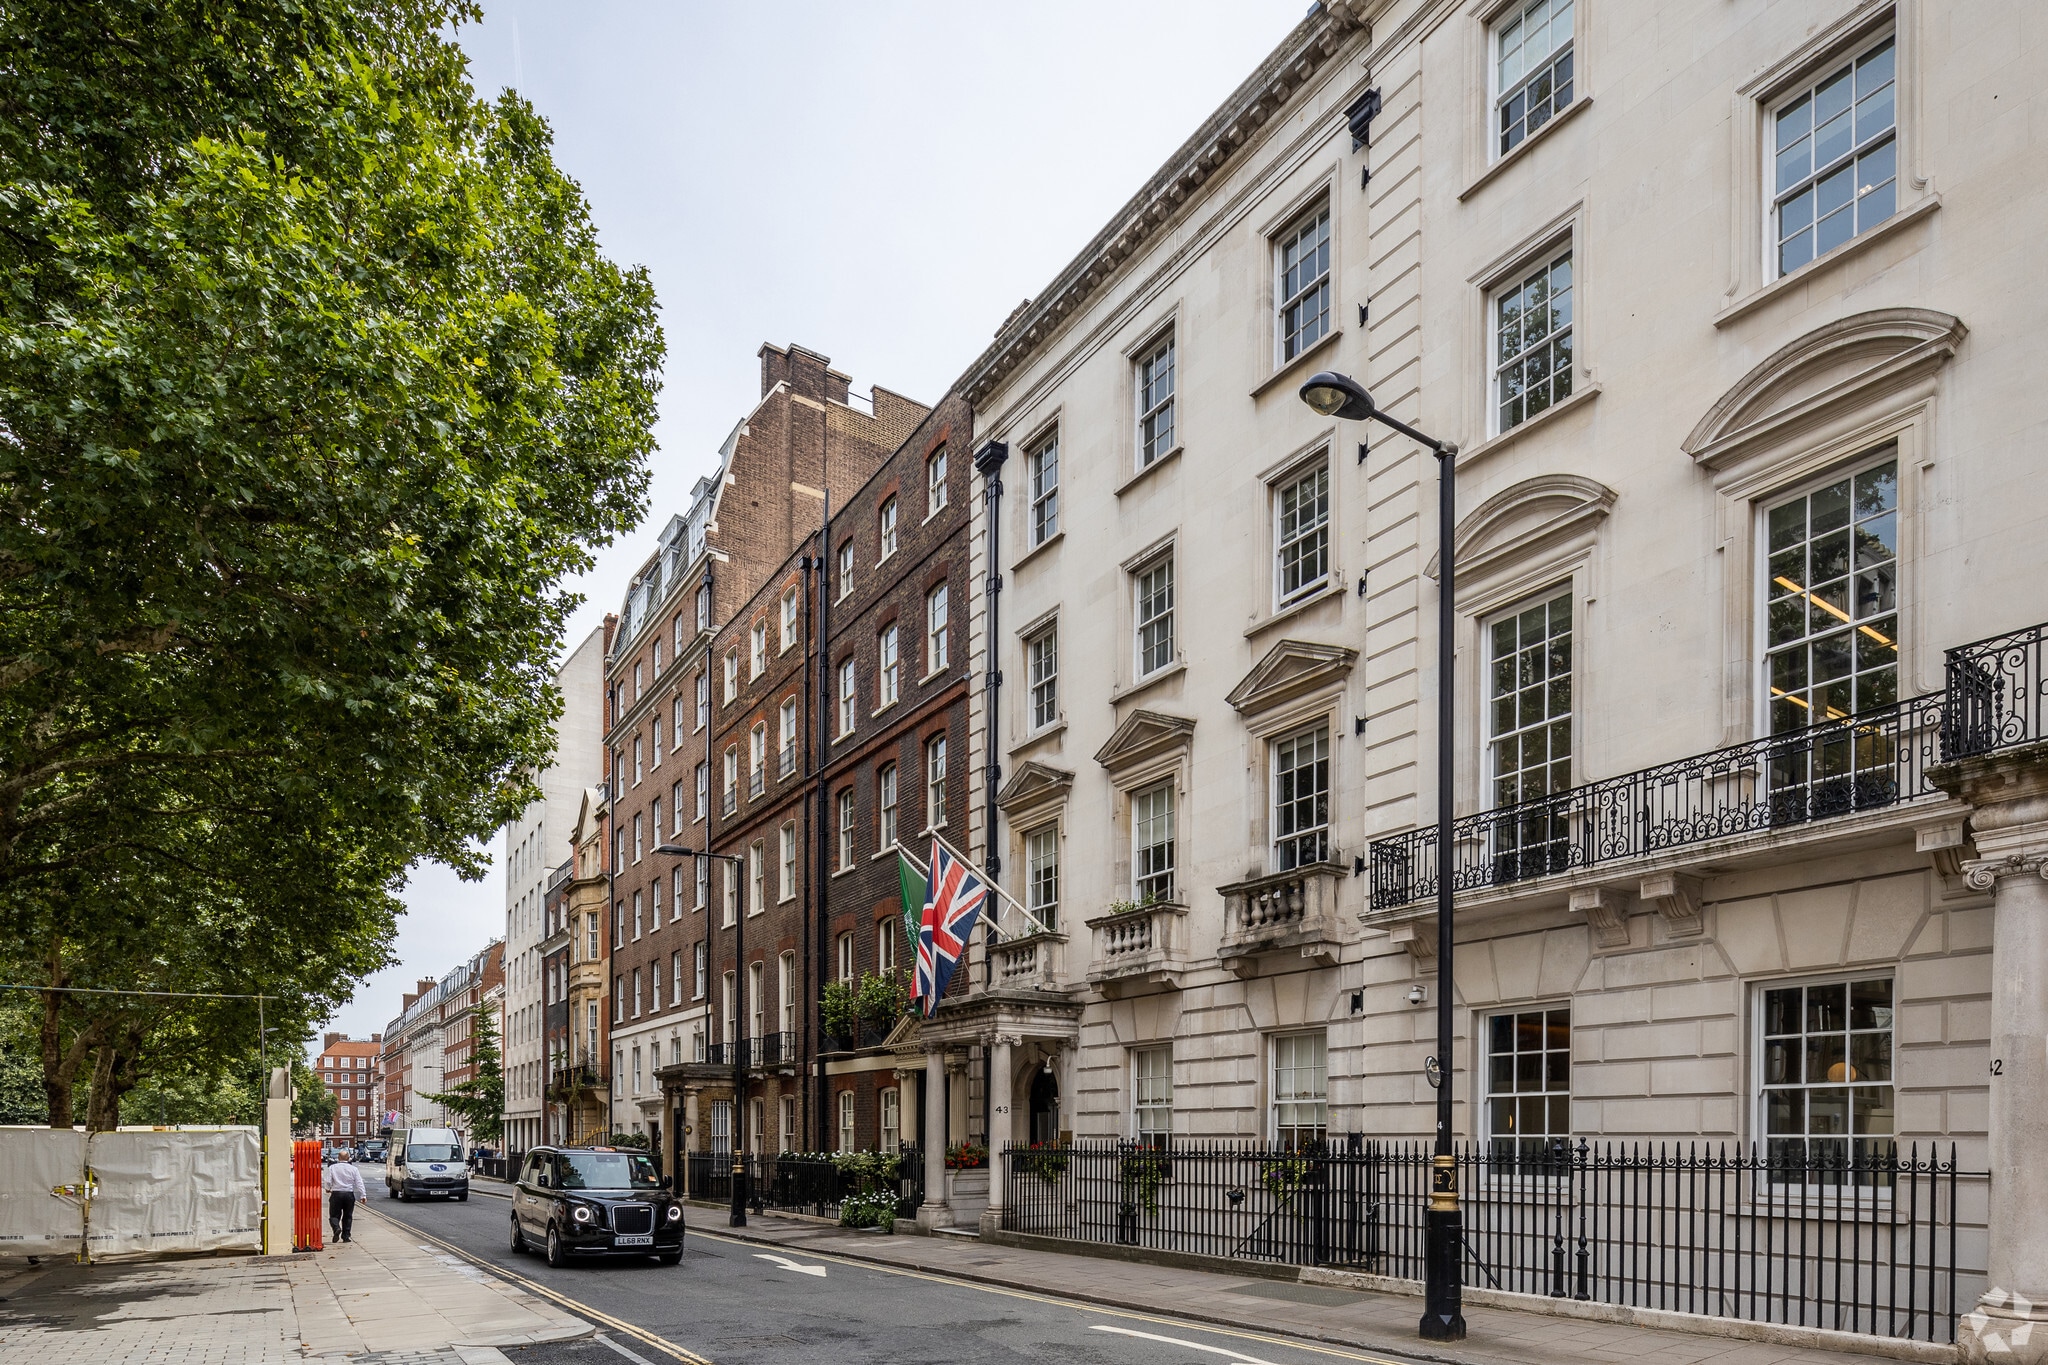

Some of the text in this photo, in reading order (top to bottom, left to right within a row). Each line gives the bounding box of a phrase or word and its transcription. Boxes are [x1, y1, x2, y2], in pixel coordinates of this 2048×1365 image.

[995, 1105, 1009, 1114] 43
[1437, 1121, 1443, 1130] 4
[618, 1237, 636, 1245] LL68
